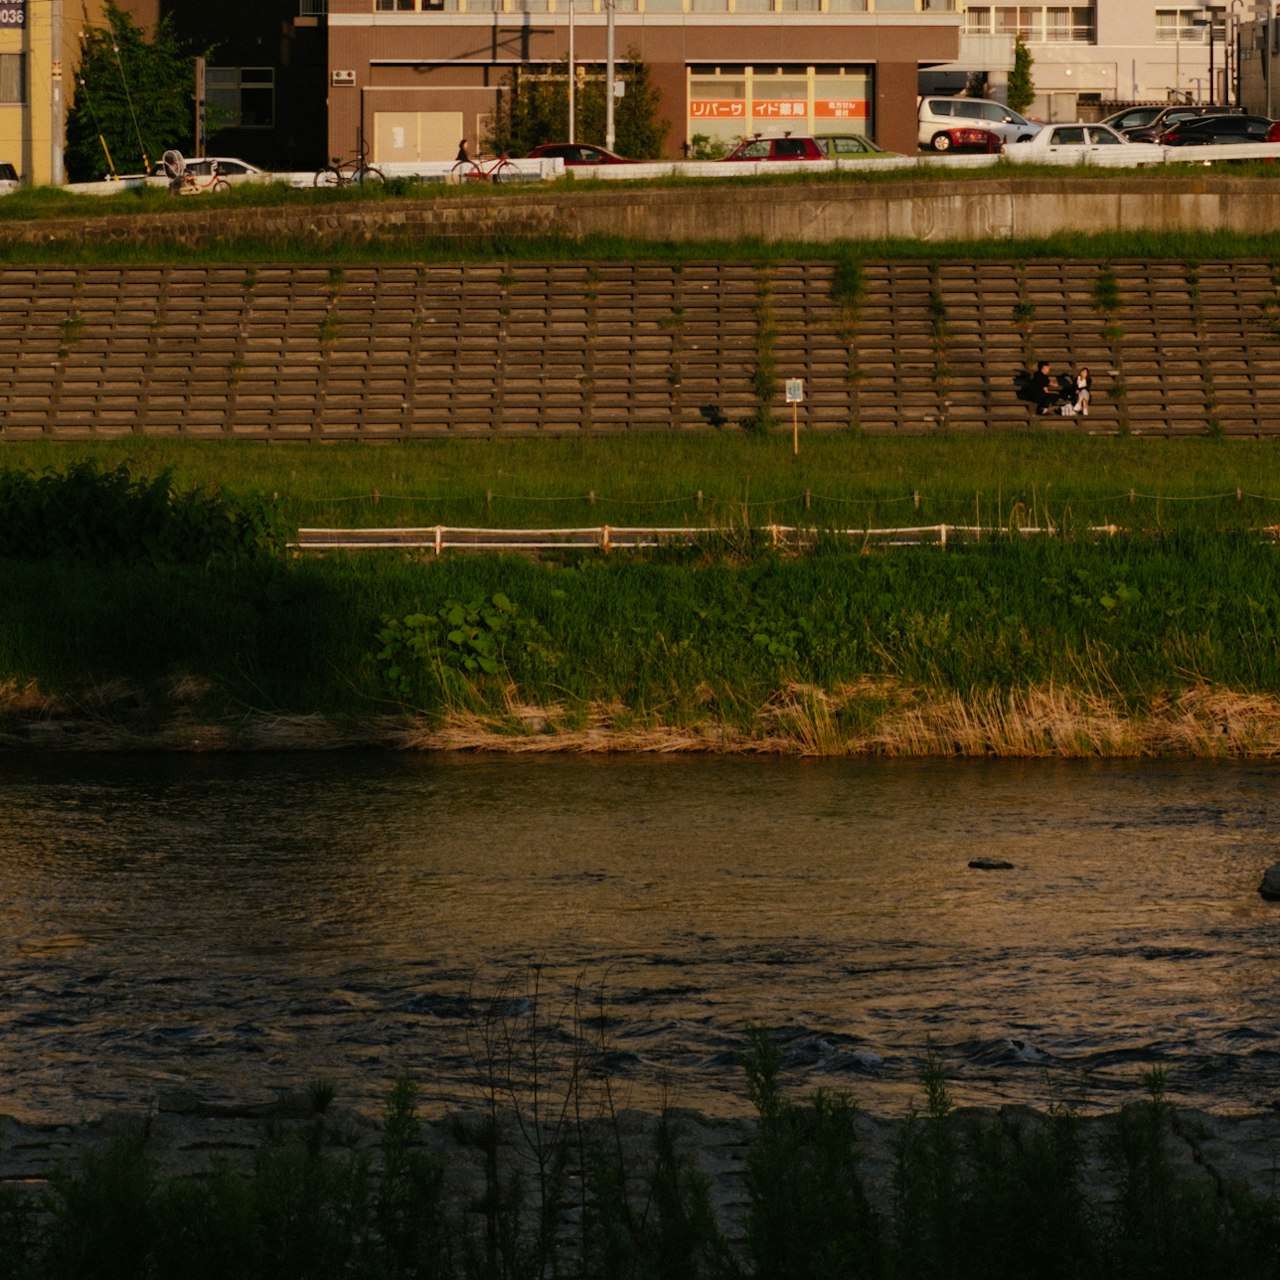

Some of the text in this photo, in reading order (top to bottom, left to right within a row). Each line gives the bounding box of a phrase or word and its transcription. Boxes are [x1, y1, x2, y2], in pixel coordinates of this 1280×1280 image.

[692, 102, 805, 116] リバーサ イド薬局
